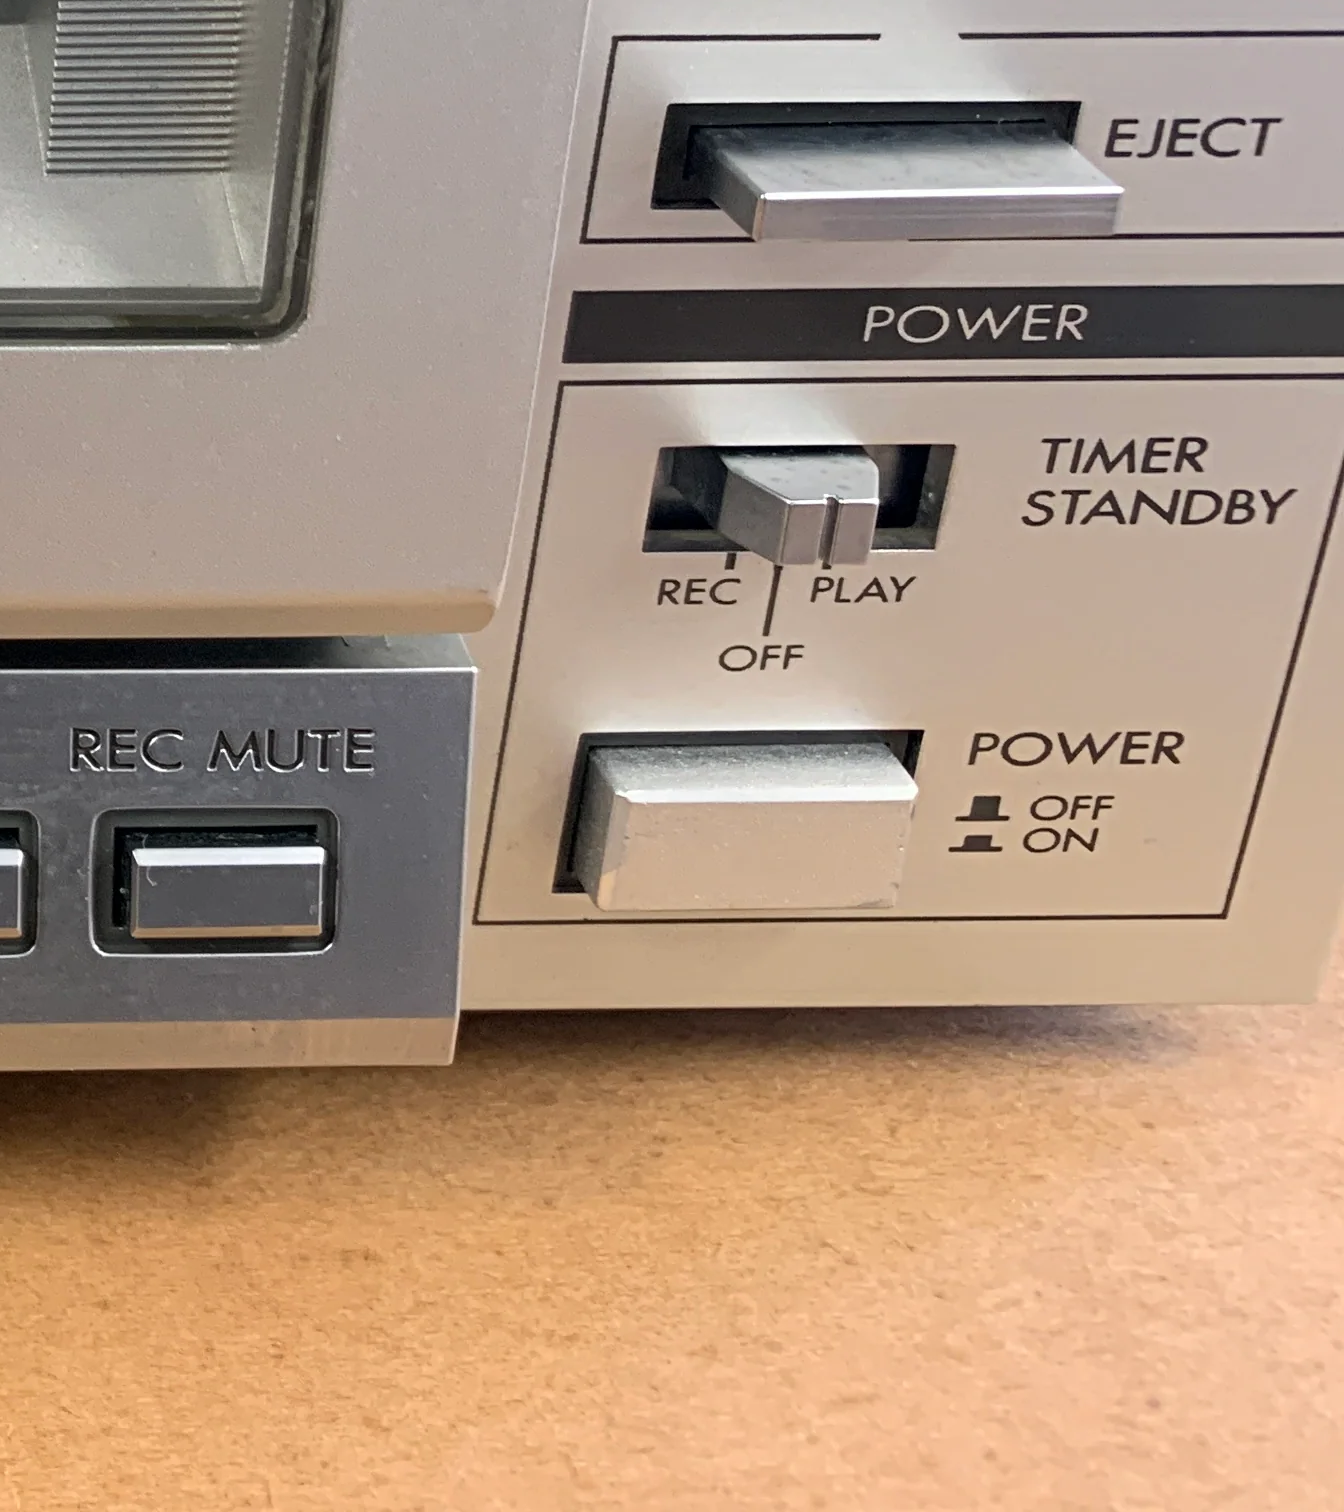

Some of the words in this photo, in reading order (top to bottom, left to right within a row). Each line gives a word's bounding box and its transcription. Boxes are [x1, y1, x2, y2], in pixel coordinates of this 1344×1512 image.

[1104, 117, 1283, 159] EJECT
[863, 303, 1089, 343] POWER
[1041, 437, 1209, 474] TIMER
[1020, 489, 1298, 527] STANDBY
[656, 577, 742, 606] REC
[810, 575, 918, 604] PLAY
[717, 644, 805, 672] OFF
[69, 727, 184, 775] REC
[209, 727, 378, 775] MUTE
[967, 731, 1186, 767] POWER
[1029, 795, 1115, 822] OFF
[1022, 826, 1099, 854] ON
